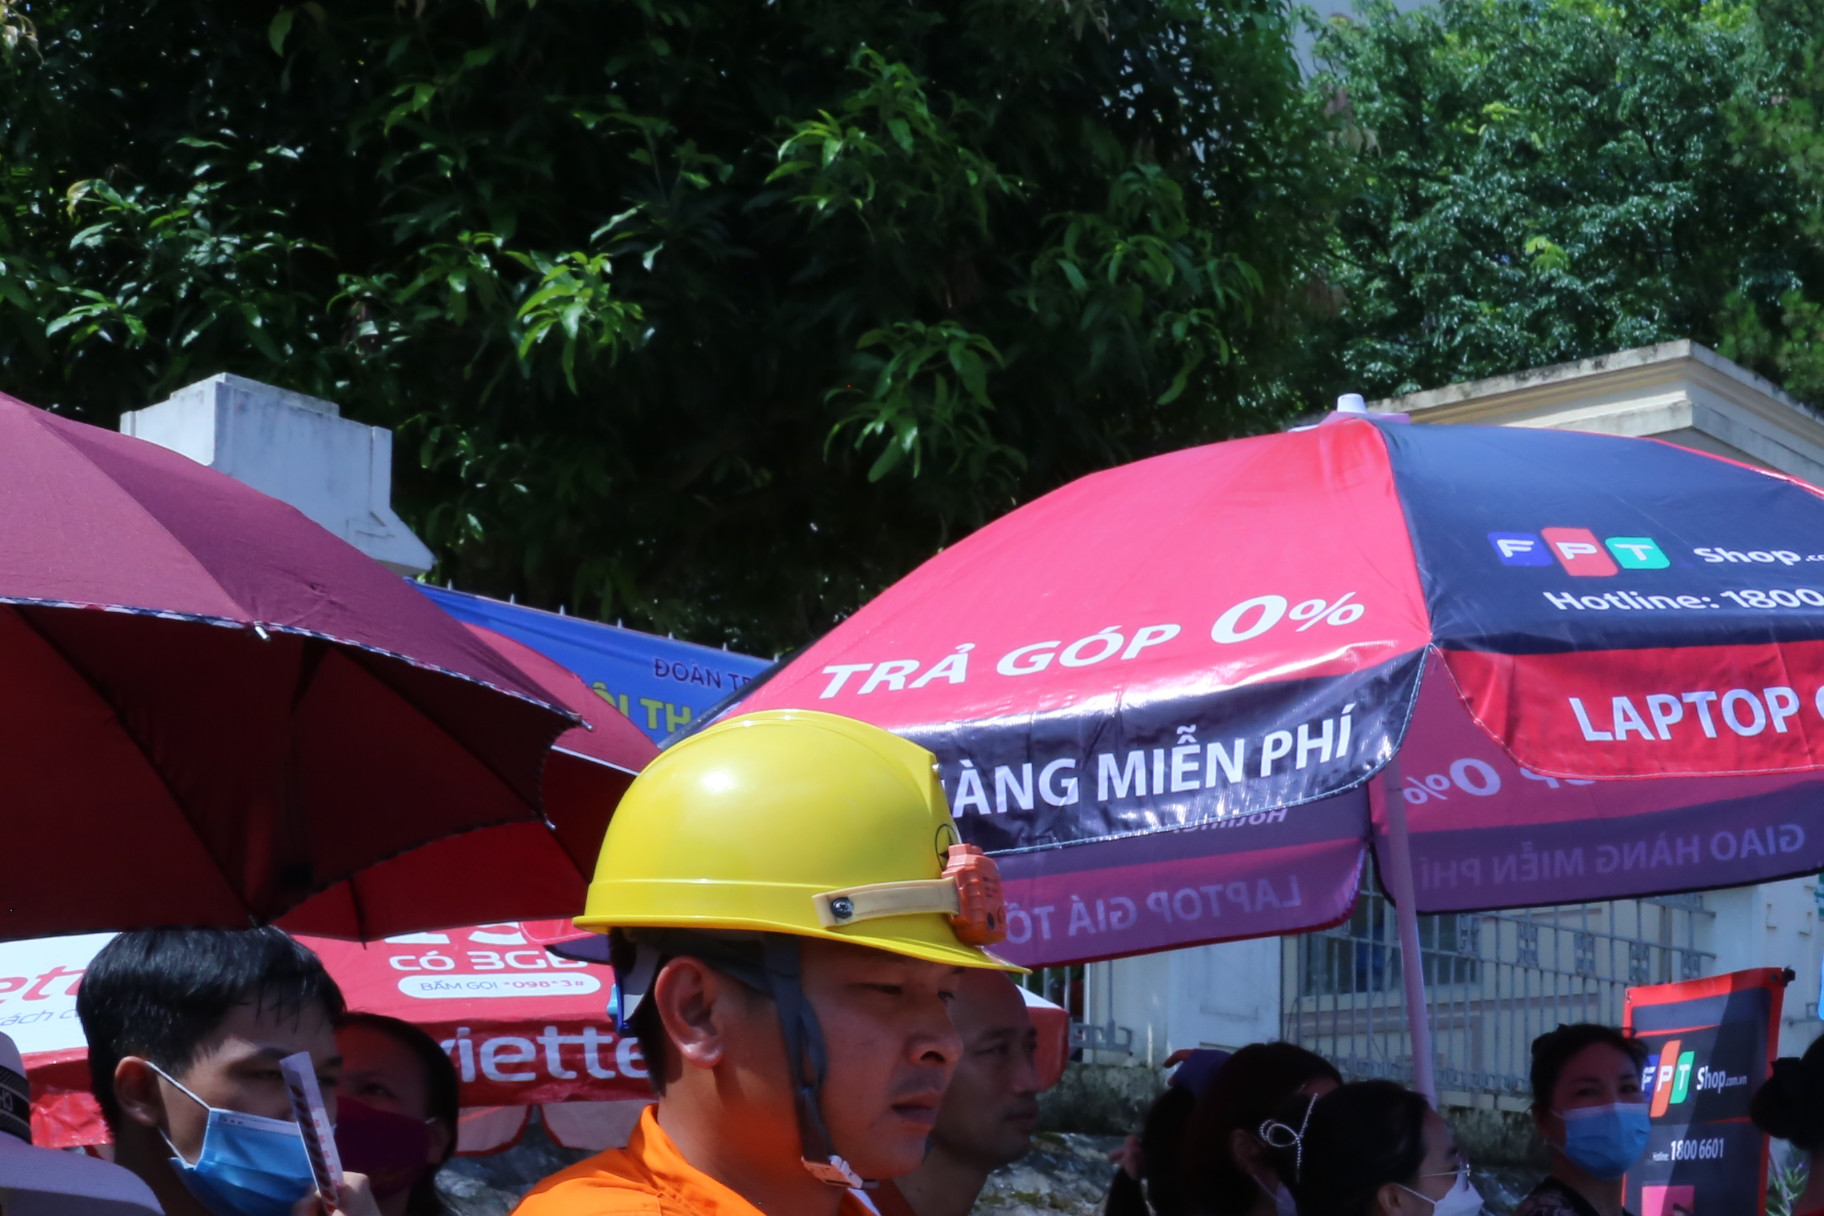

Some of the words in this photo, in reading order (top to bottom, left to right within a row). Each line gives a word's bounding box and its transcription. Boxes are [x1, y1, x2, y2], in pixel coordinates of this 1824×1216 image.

[1496, 538, 1654, 564] FPT
[1542, 591, 1719, 610] Hotline:
[818, 643, 967, 700] TRẢ
[996, 624, 1181, 677] GÓP
[1209, 593, 1365, 645] 0%
[653, 657, 722, 690] ĐOÀN
[1568, 686, 1800, 742] LAPTOP
[950, 754, 1081, 820] ÀNG
[1096, 722, 1246, 802] MIỄN
[1260, 703, 1353, 778] PHÍ
[389, 950, 455, 971] CÓ
[420, 979, 462, 992] BẤM
[0, 1009, 54, 1027] ách
[438, 1026, 651, 1083] iette
[1641, 1063, 1691, 1092] FPT
[1670, 1139, 1698, 1161] 1800
[1698, 1137, 1725, 1160] 6601
